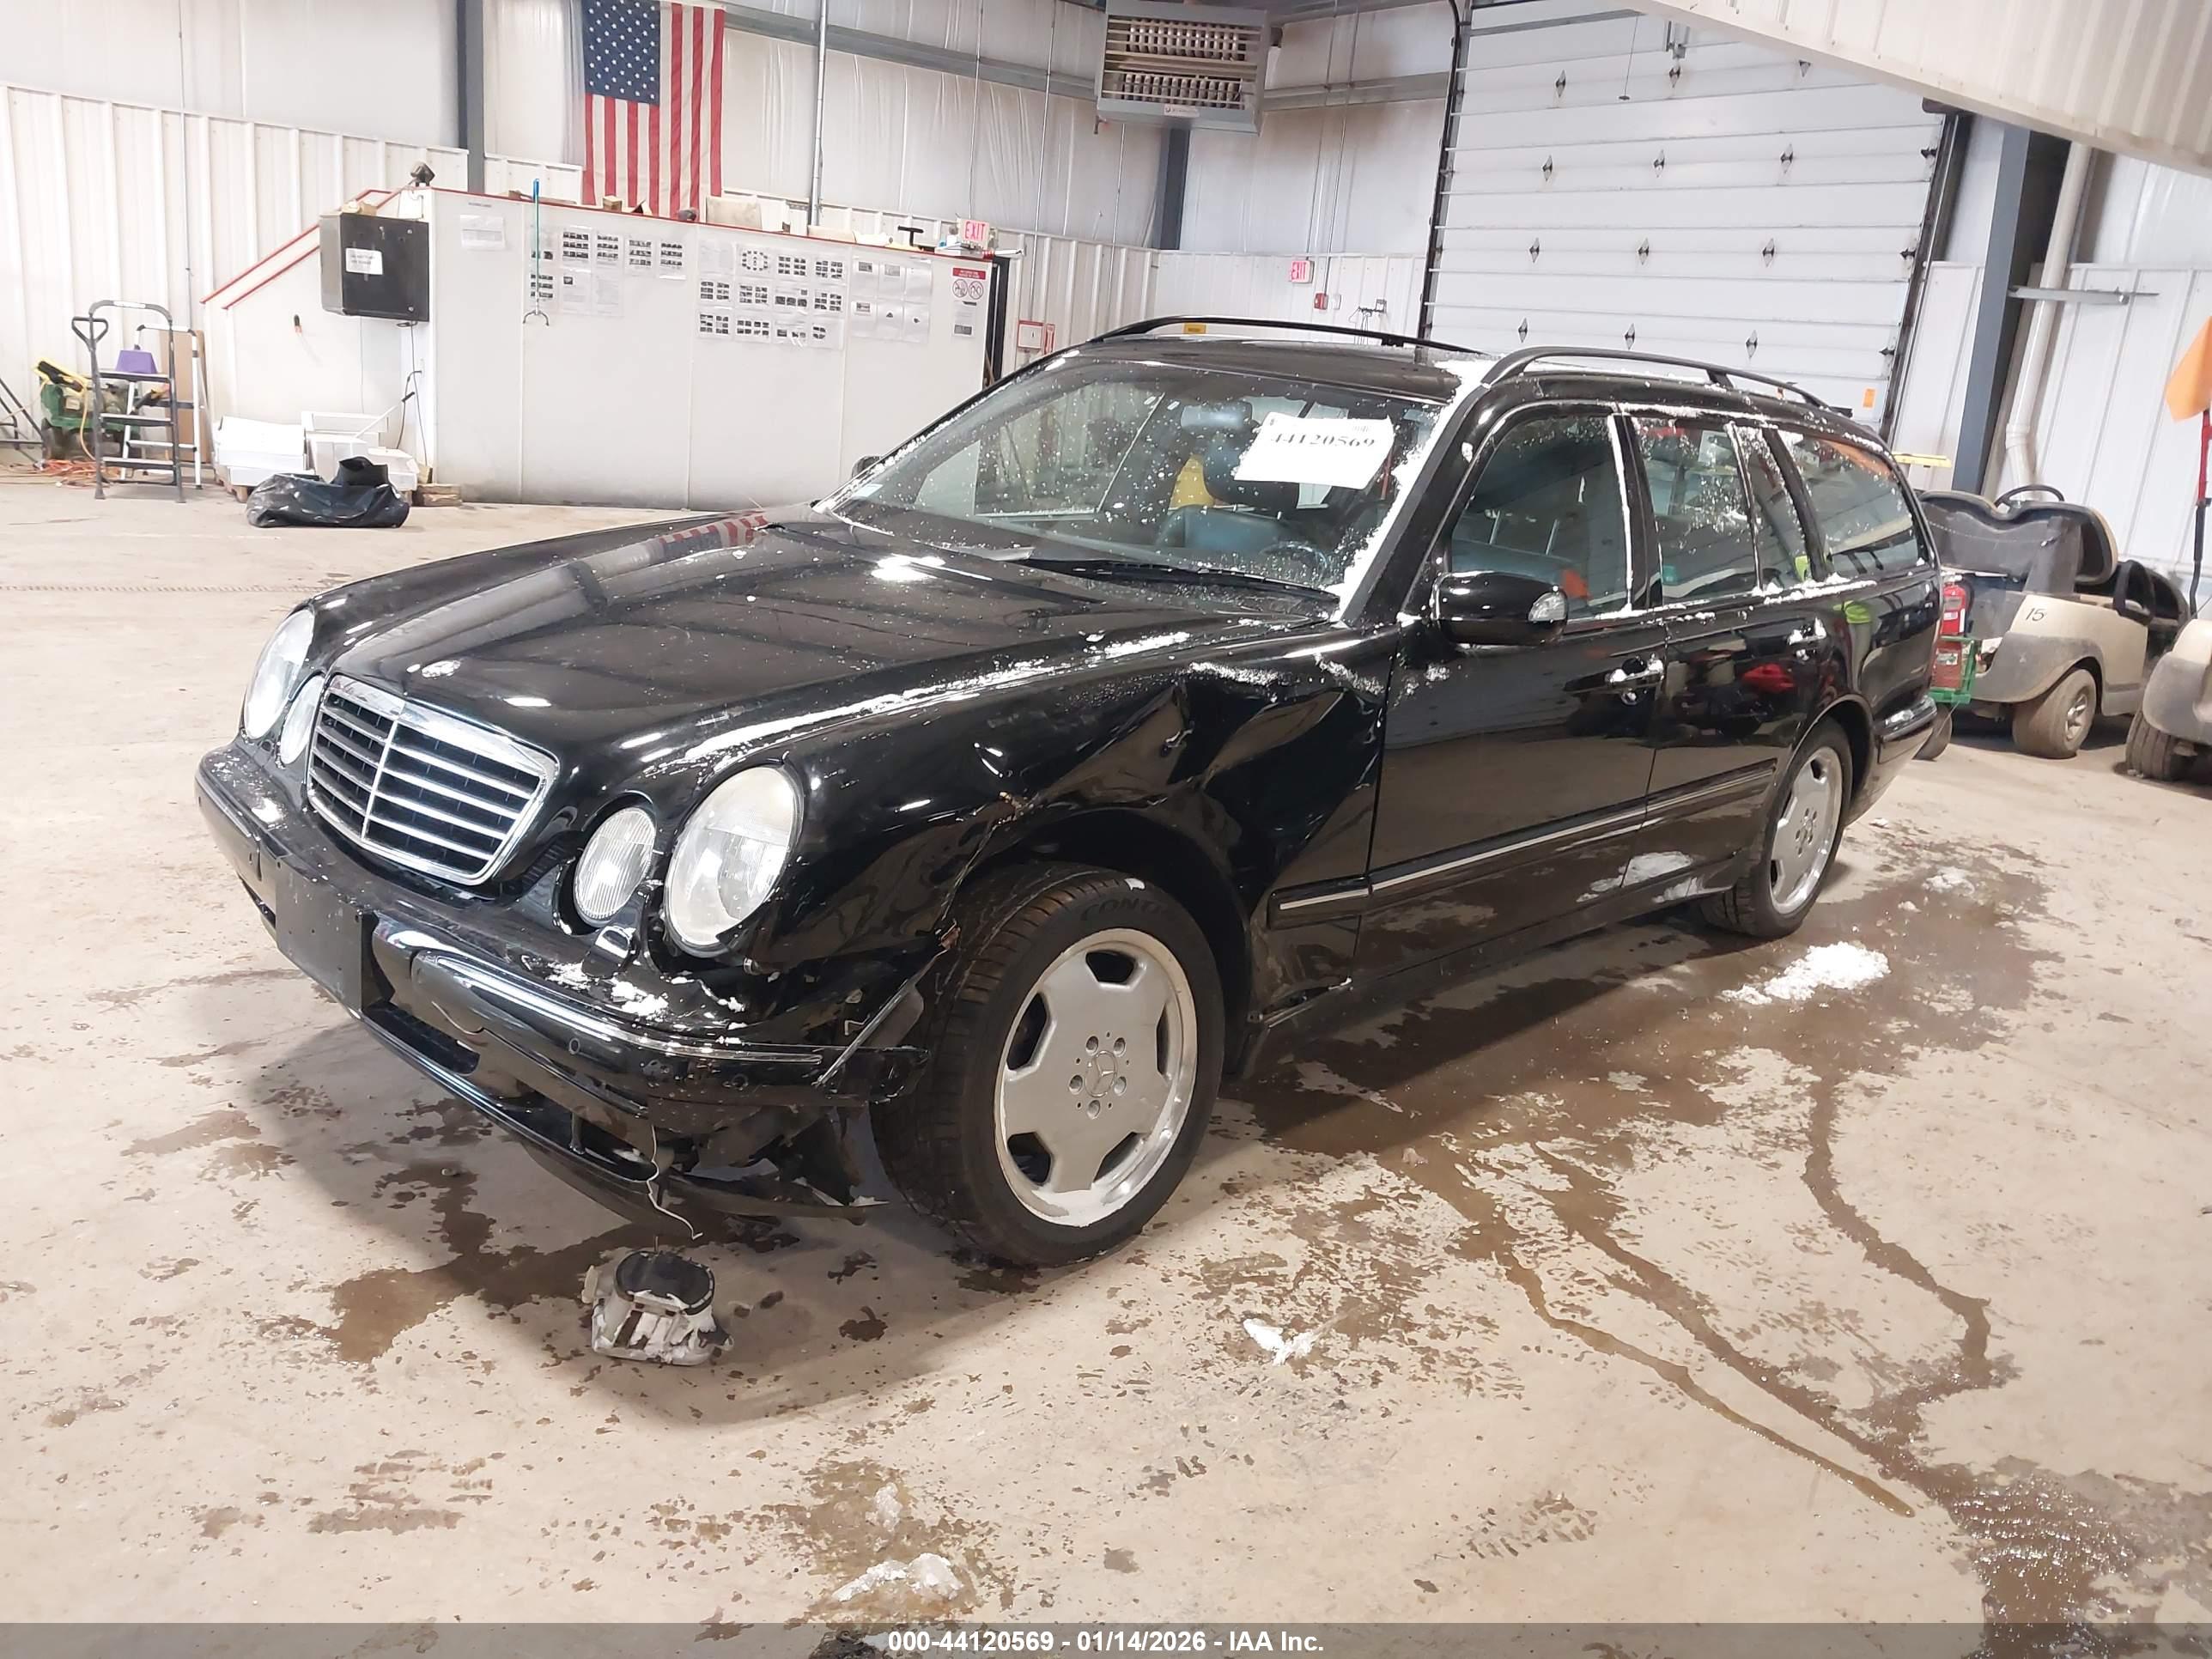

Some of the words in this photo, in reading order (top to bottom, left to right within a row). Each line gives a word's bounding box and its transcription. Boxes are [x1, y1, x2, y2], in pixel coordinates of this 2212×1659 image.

[964, 221, 987, 241] EXIT
[1291, 261, 1307, 281] EXIT
[1270, 432, 1376, 447] 44120569
[2025, 607, 2046, 622] 15
